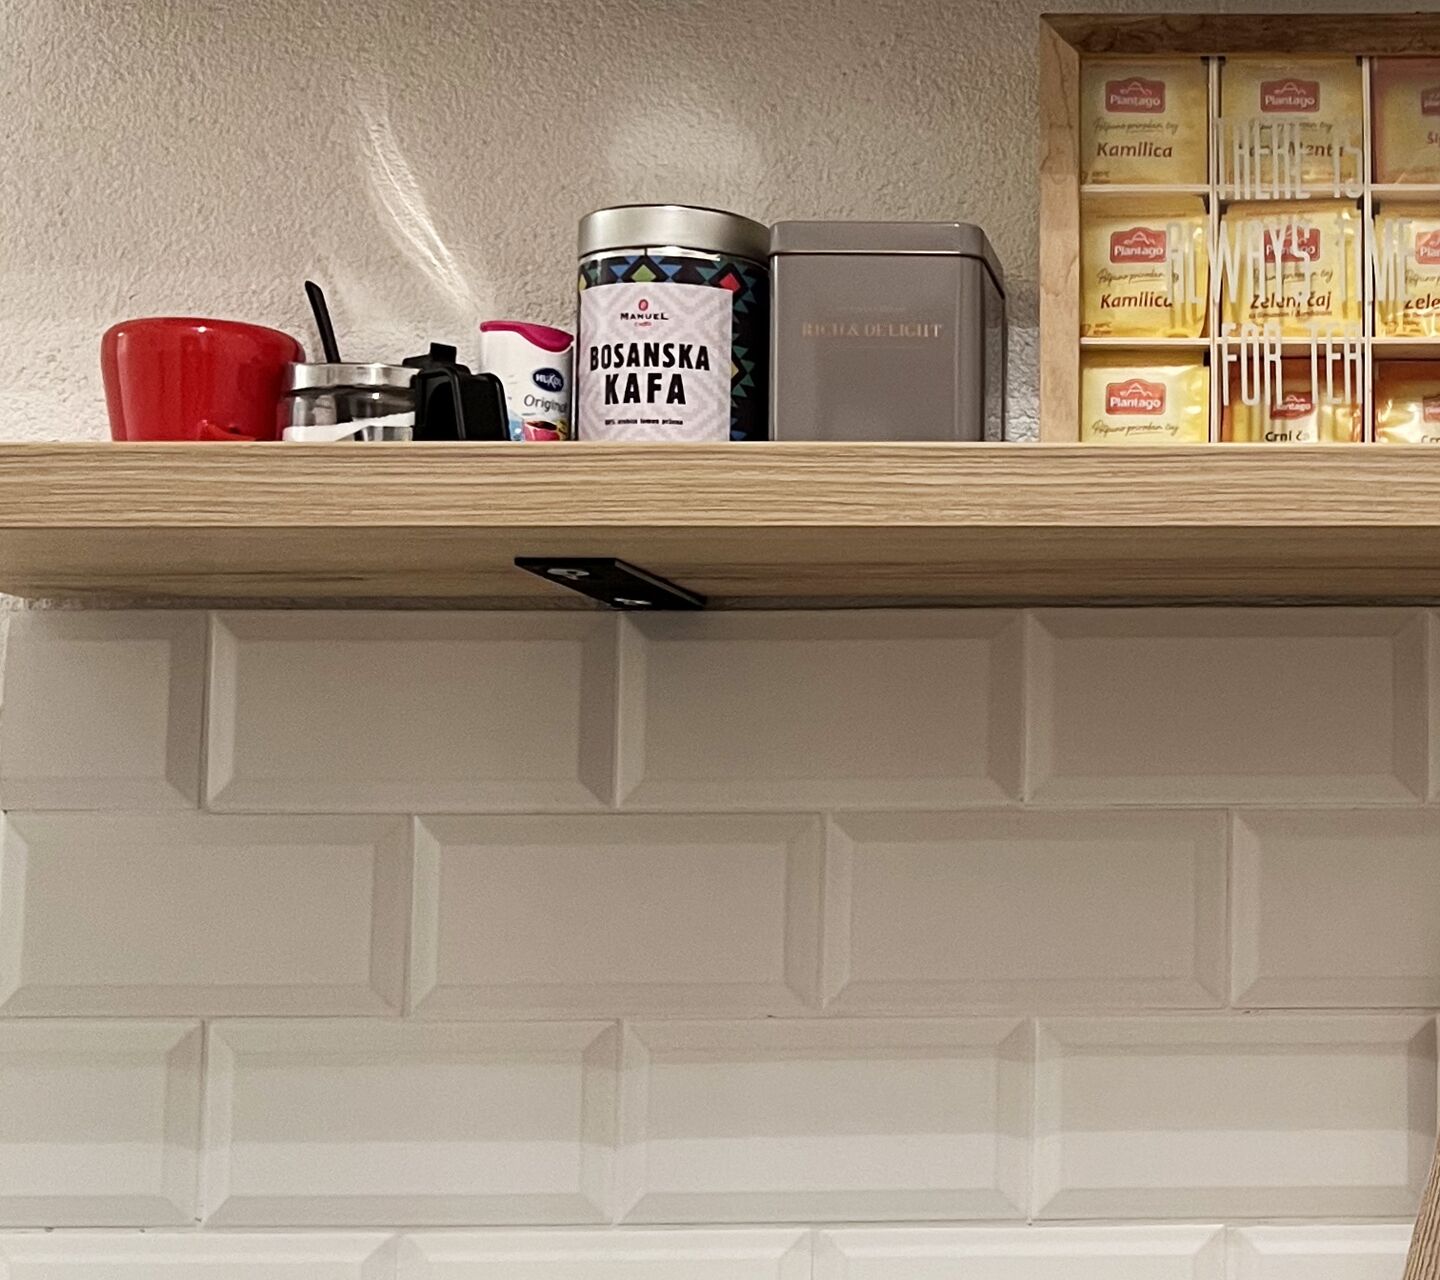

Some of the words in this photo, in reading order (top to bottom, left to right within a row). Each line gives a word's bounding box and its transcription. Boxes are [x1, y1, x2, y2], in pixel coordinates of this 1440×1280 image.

[1110, 94, 1161, 109] Plantago
[1096, 142, 1173, 158] Kamilica
[1114, 245, 1164, 259] Plantago
[1166, 217, 1311, 304] ALWAYS
[1335, 218, 1413, 304] TIME
[1307, 290, 1332, 310] čaj
[620, 313, 669, 321] MANUEL
[590, 342, 710, 371] BOSANSKA
[1220, 320, 1282, 407] FOR
[1309, 320, 1364, 406] TEA
[605, 373, 687, 405] KAFA
[1110, 396, 1161, 410] Plantago
